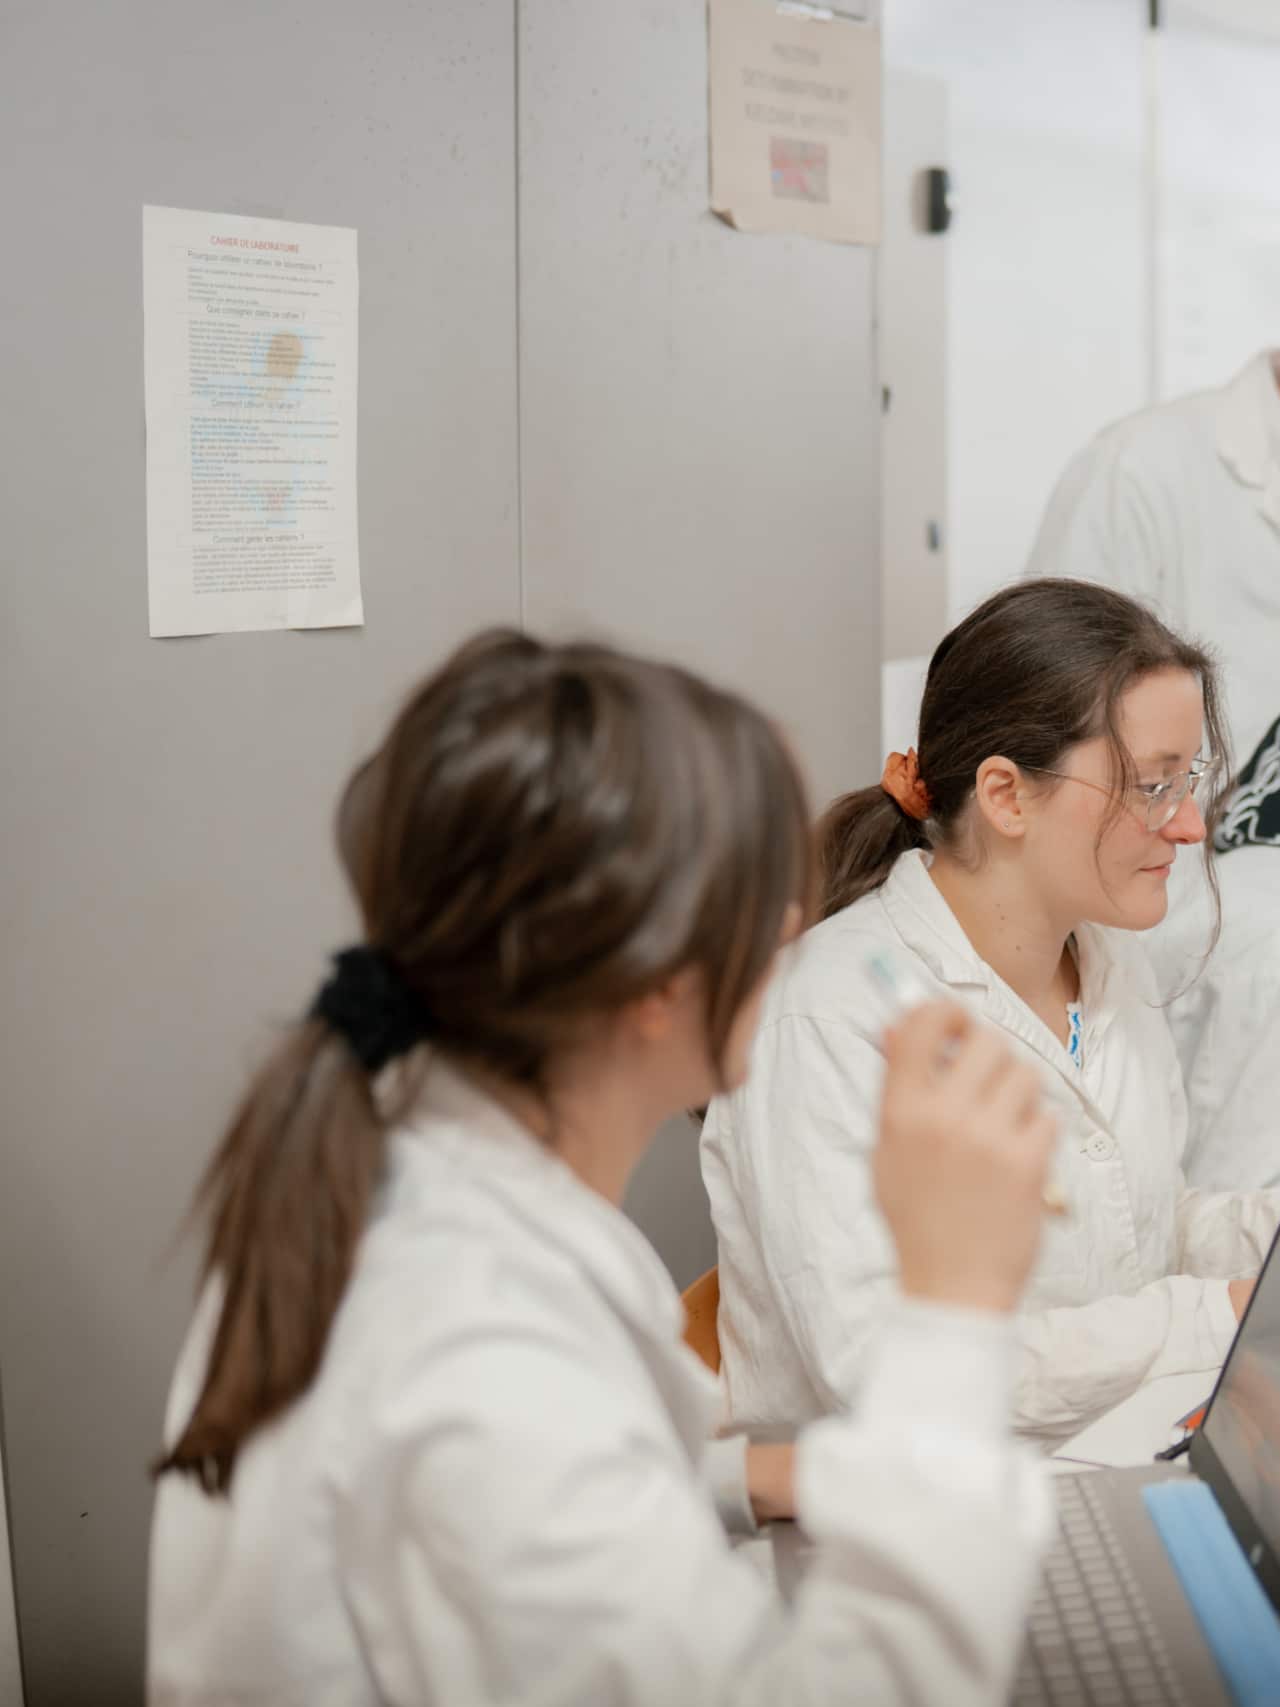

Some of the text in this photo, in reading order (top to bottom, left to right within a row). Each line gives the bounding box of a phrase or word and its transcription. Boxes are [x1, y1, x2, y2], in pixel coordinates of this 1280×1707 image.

[209, 235, 238, 247] CAHIER
[250, 240, 299, 253] LABORATOIRE
[212, 535, 243, 545] Comment
